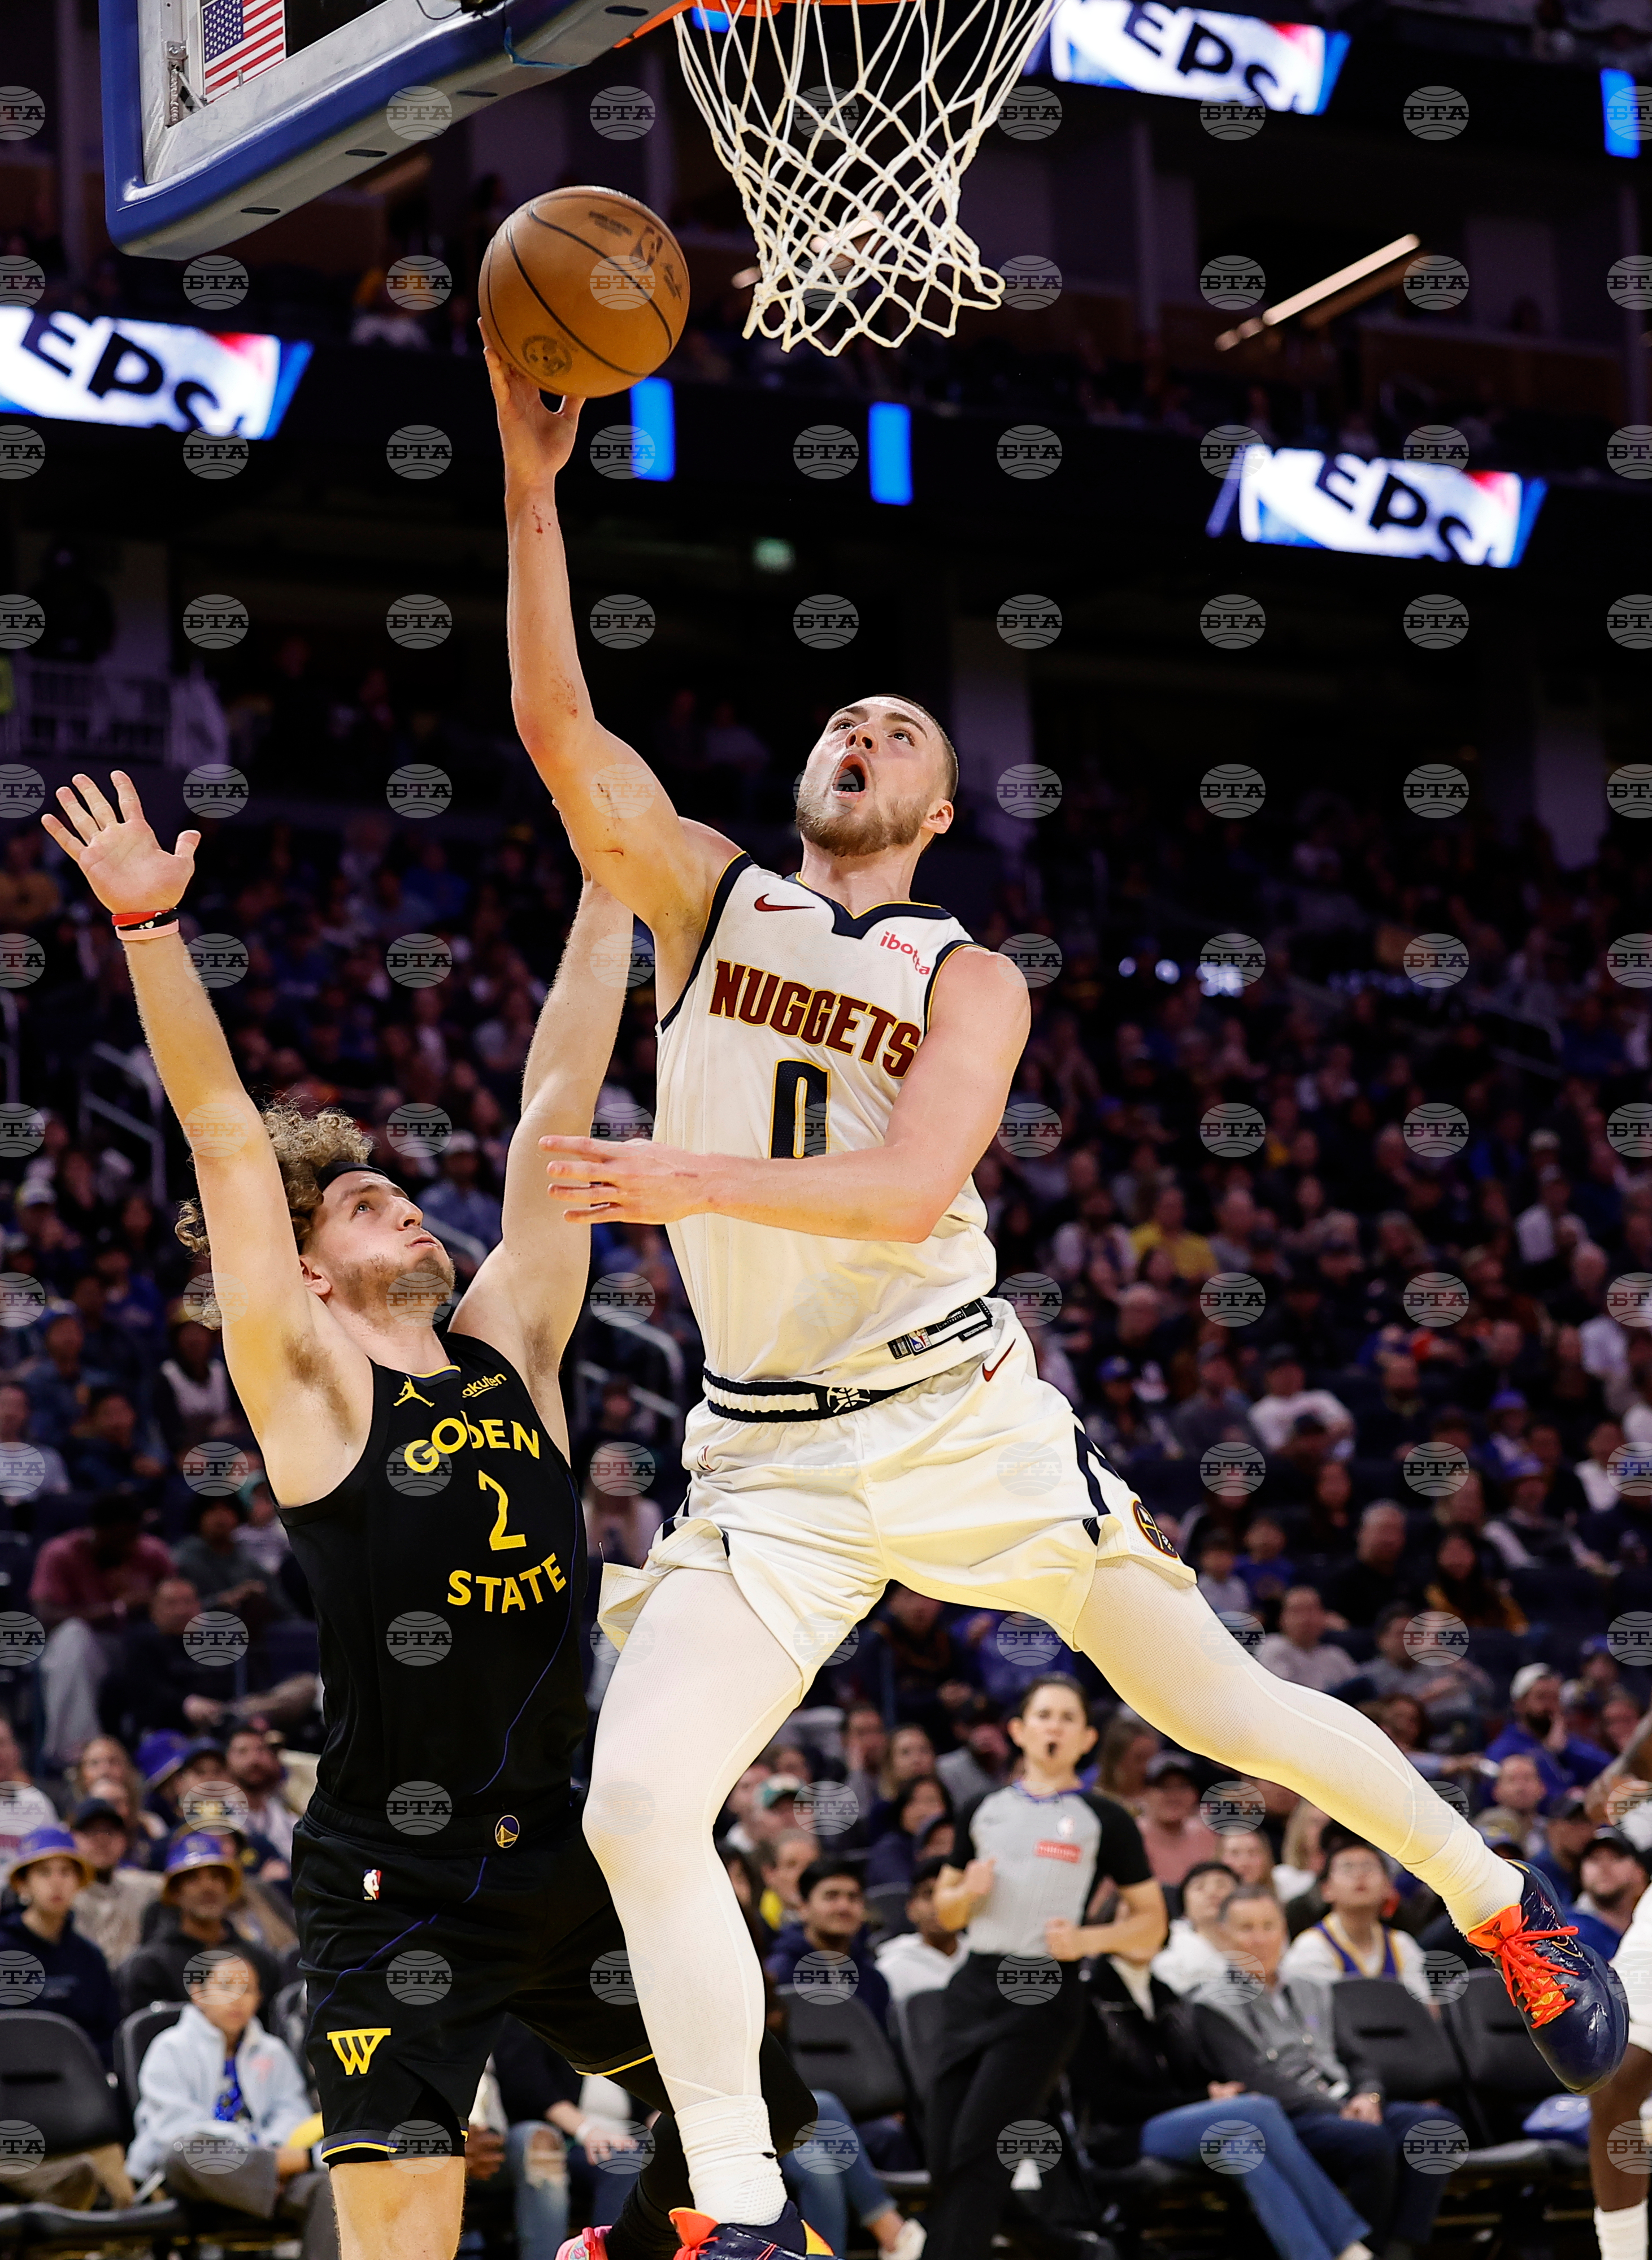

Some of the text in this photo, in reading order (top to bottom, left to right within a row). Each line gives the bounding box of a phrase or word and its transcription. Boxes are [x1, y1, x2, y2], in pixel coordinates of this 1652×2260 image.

[880, 931, 931, 975] ibotta
[708, 959, 921, 1079] NUGGETS
[768, 1058, 830, 1159] 0
[462, 1373, 507, 1398] akuten
[404, 1410, 540, 1473] GODEN
[479, 1470, 527, 1550] 2
[447, 1553, 566, 1614] STATE
